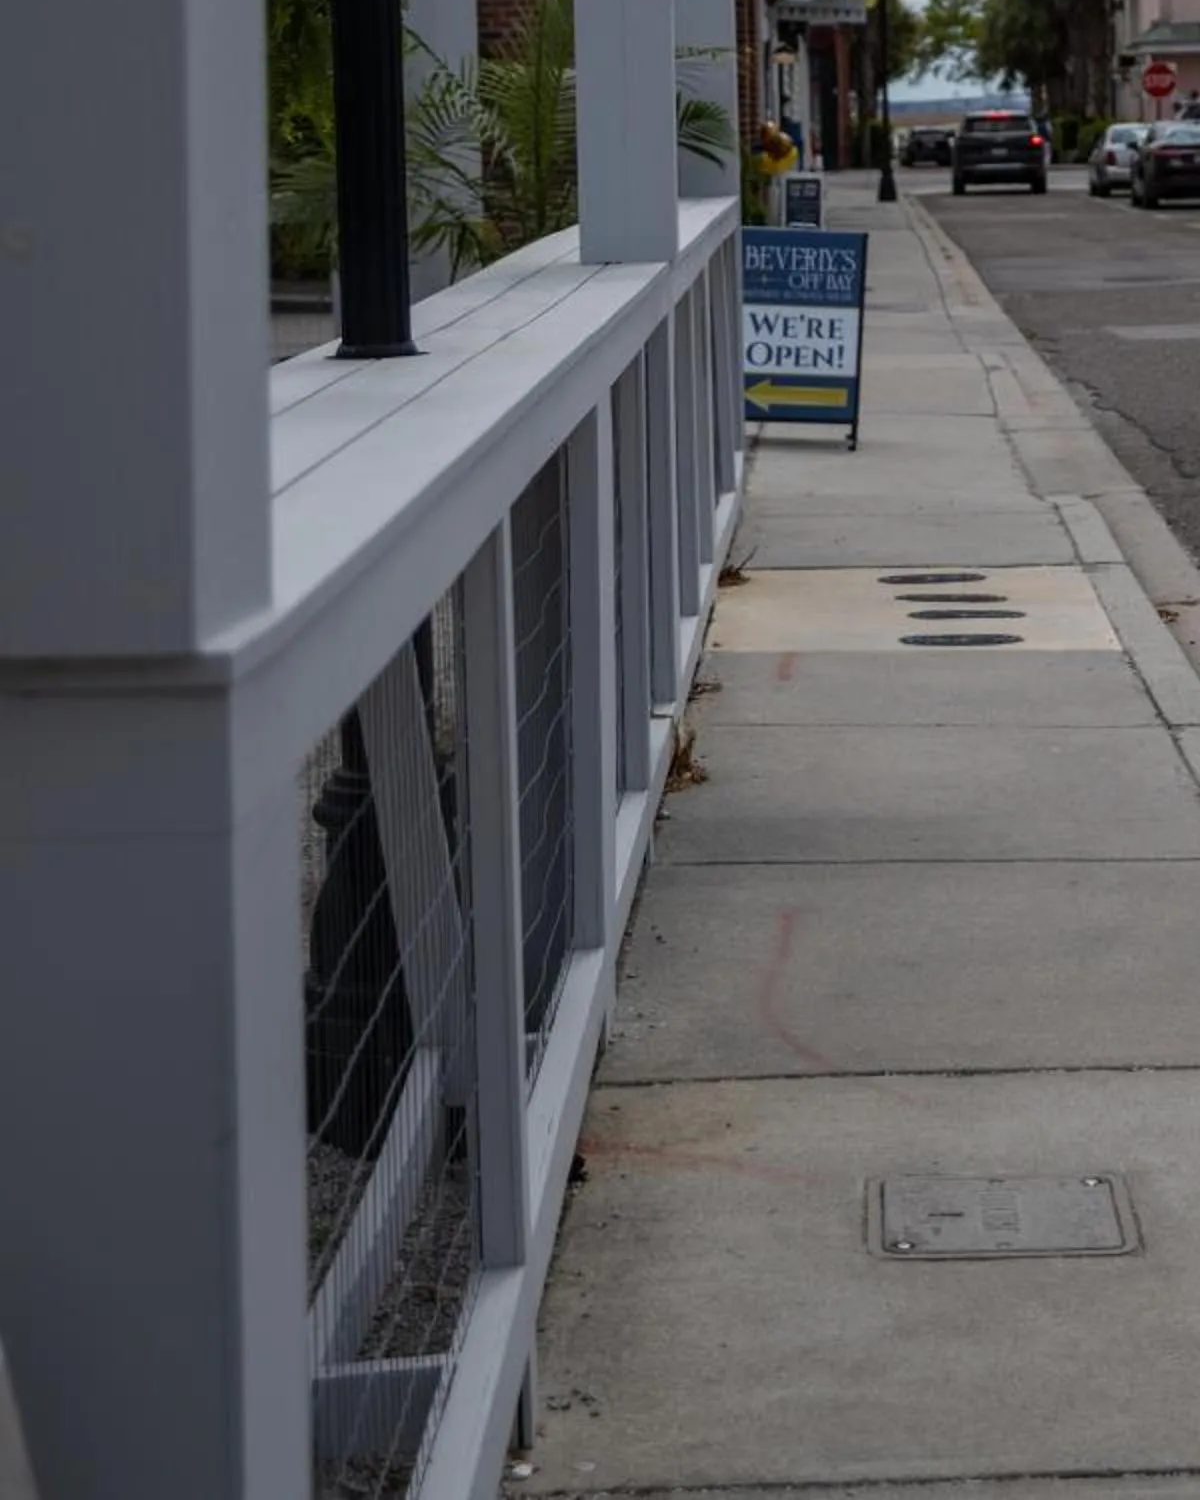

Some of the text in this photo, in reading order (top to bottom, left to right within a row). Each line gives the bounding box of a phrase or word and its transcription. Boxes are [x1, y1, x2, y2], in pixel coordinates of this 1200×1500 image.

[744, 245, 856, 273] BEVERLY'S
[827, 273, 856, 291] BAY
[749, 311, 844, 340] WE'RE
[746, 341, 844, 369] OPEN!
